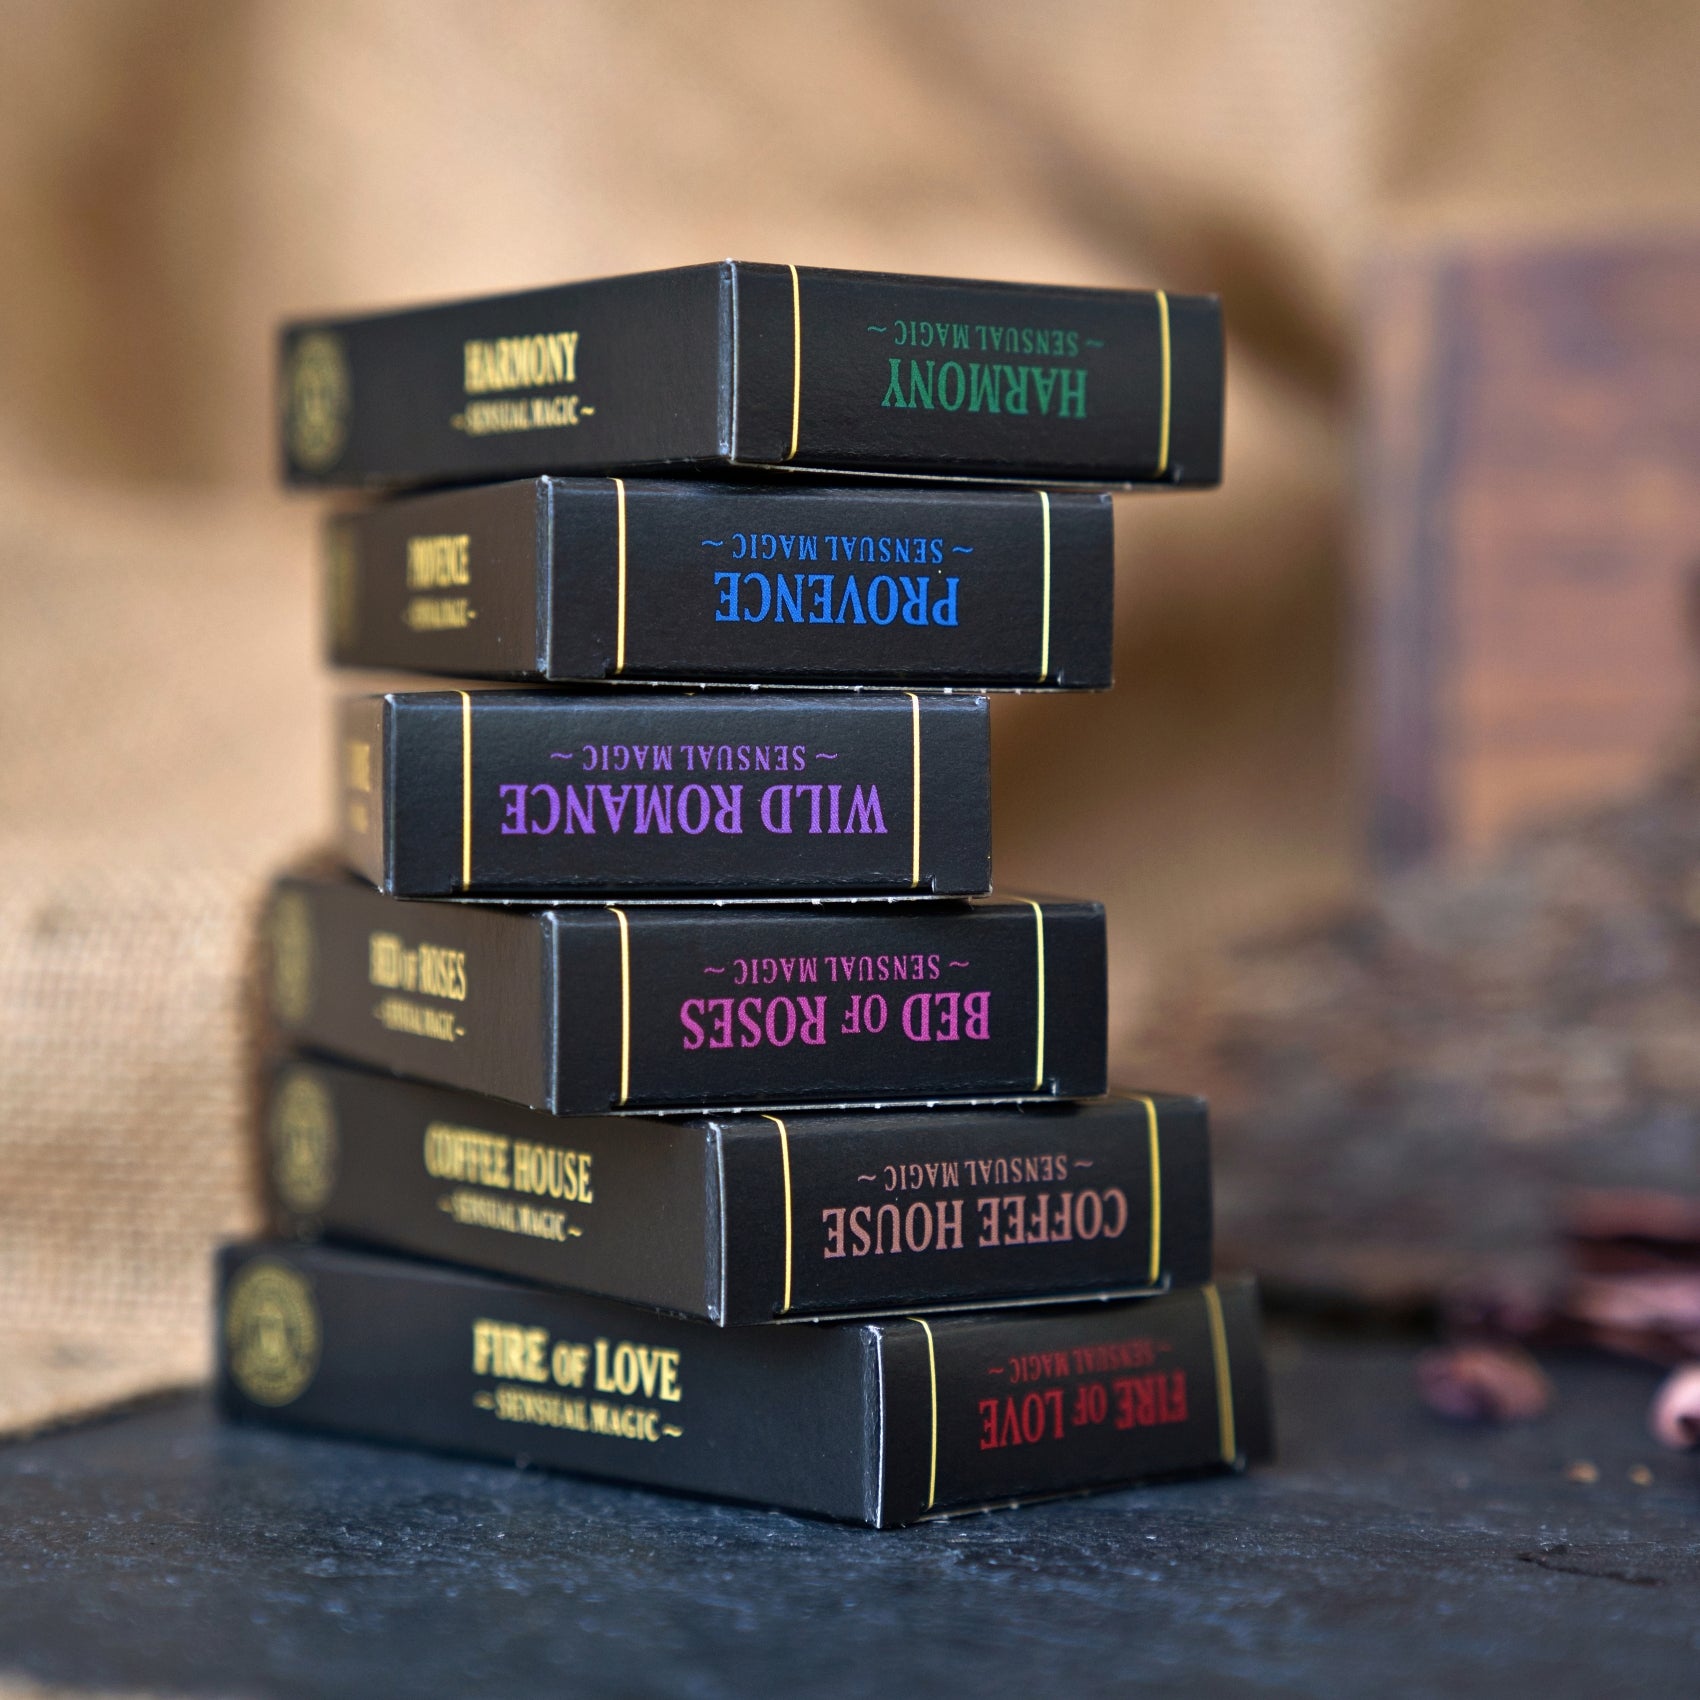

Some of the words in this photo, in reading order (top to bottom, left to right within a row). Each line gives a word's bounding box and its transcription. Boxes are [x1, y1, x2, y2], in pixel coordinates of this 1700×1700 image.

[894, 320, 970, 350] MAGIC
[976, 325, 1079, 357] SENSUAL
[464, 331, 579, 395] HARMONY
[881, 358, 1088, 419] HARMONY
[732, 533, 818, 561] MAGIC
[825, 536, 943, 564] SENSUAL
[714, 571, 960, 627] PROVENCE
[582, 745, 672, 770] MAGIC
[680, 746, 806, 771] SENSUAL
[499, 784, 744, 836] ROMANCE
[760, 784, 888, 835] WILD
[733, 957, 818, 986] MAGIC
[824, 954, 941, 982] SENSUAL
[680, 995, 827, 1051] ROSES
[841, 994, 888, 1035] OF
[902, 991, 991, 1042] BED
[513, 1139, 593, 1204] HOUSE
[884, 1161, 960, 1191] MAGIC
[964, 1155, 1068, 1187] SENSUAL
[822, 1200, 964, 1259] HOUSE
[977, 1188, 1129, 1248] COFFEE
[472, 1317, 550, 1384] FIRE
[551, 1341, 590, 1388] OF
[593, 1337, 683, 1402] LOVE
[1009, 1350, 1069, 1384] MAGIC
[494, 1387, 589, 1432] SENSUAL
[590, 1402, 661, 1442] MAGIC
[979, 1386, 1066, 1451] LOVE
[1072, 1379, 1108, 1427] OF
[1113, 1368, 1189, 1431] FIRE
